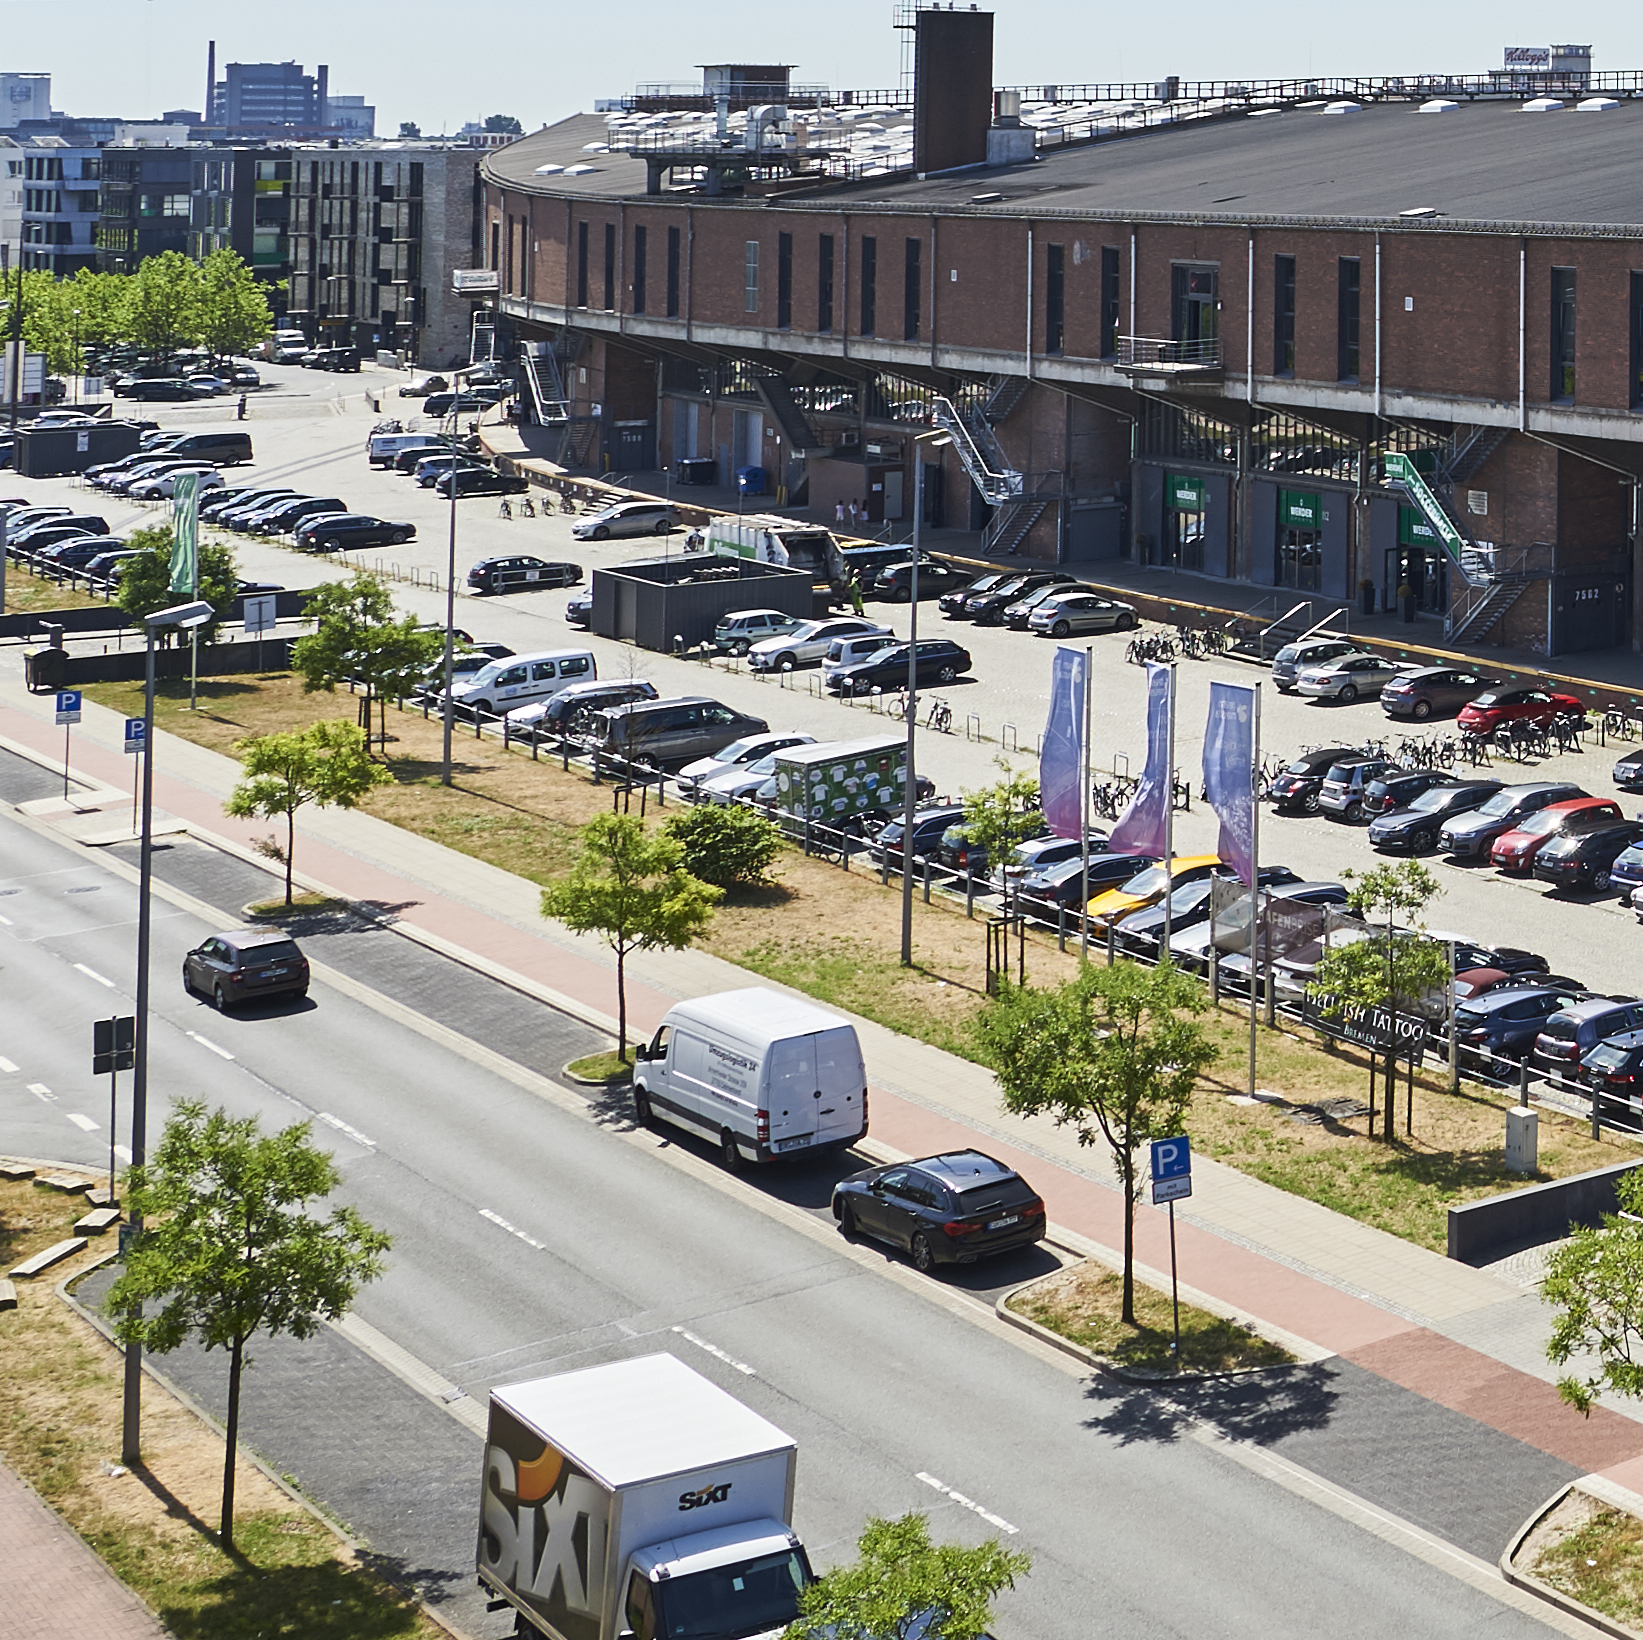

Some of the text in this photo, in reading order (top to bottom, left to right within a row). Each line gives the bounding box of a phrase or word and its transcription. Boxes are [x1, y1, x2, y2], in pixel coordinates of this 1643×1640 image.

[1176, 489, 1197, 501] WERDER
[1290, 506, 1313, 518] WERDER
[1412, 525, 1435, 537] WERDE
[62, 693, 76, 710] P
[1259, 908, 1319, 937] AFENBRISE
[1372, 1009, 1424, 1040] TATTOO
[1158, 1144, 1178, 1175] P
[1156, 1188, 1189, 1200] Parkschein
[678, 1482, 733, 1511] SIXT
